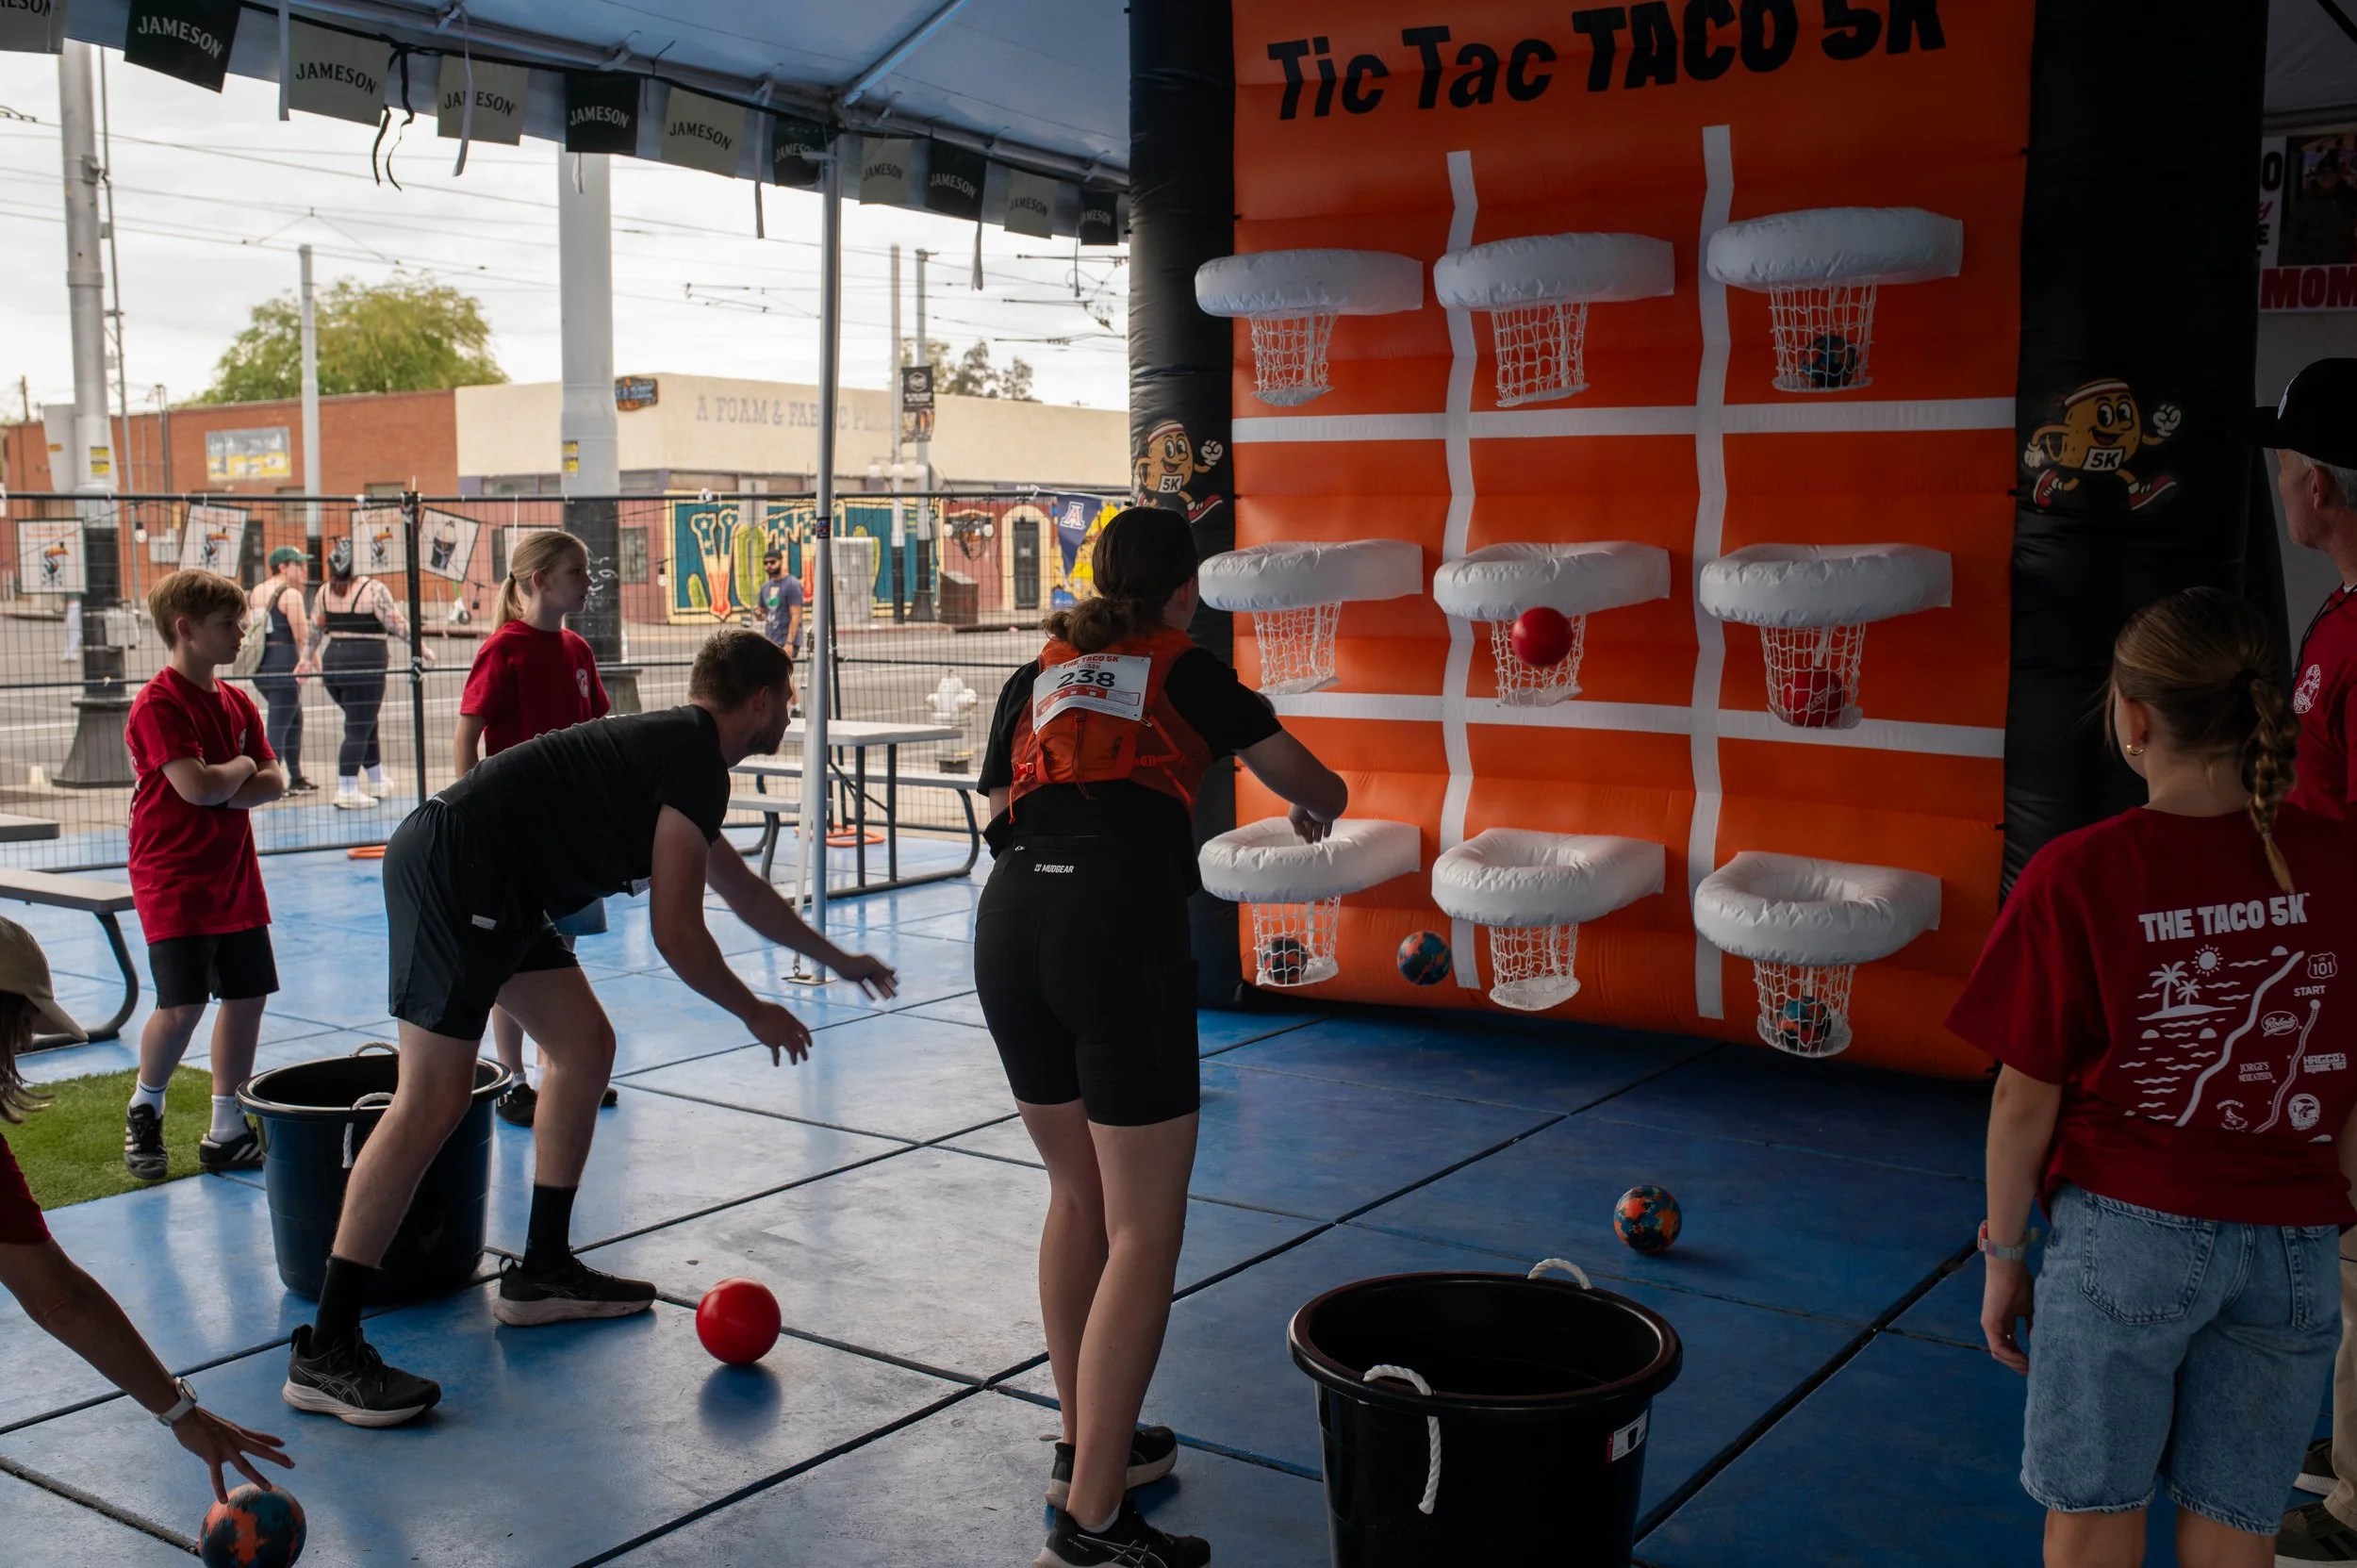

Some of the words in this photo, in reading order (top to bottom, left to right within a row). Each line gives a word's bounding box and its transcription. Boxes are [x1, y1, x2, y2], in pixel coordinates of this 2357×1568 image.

[138, 15, 223, 59] JAMESON
[1267, 36, 1389, 121] Tic
[1402, 25, 1557, 110] Tac
[1572, 0, 1798, 92] TACO
[296, 62, 377, 95] JAMESON
[569, 106, 629, 129] JAMESON
[669, 121, 733, 151] JAMESON
[864, 162, 903, 180] JAMESON
[929, 173, 977, 199] JAMESON
[1008, 196, 1047, 218] JAMESON
[696, 395, 709, 421] A
[715, 397, 768, 426] FOAM
[772, 402, 785, 426] &
[2090, 452, 2118, 469] 5K
[1162, 477, 1180, 491] 5K
[1063, 659, 1080, 669] THE
[1057, 668, 1115, 689] 238
[1041, 864, 1075, 873] MUDGEAR
[2137, 908, 2195, 943] THE
[2197, 900, 2266, 935] TACO
[2313, 961, 2333, 976] 101
[2293, 984, 2327, 997] START
